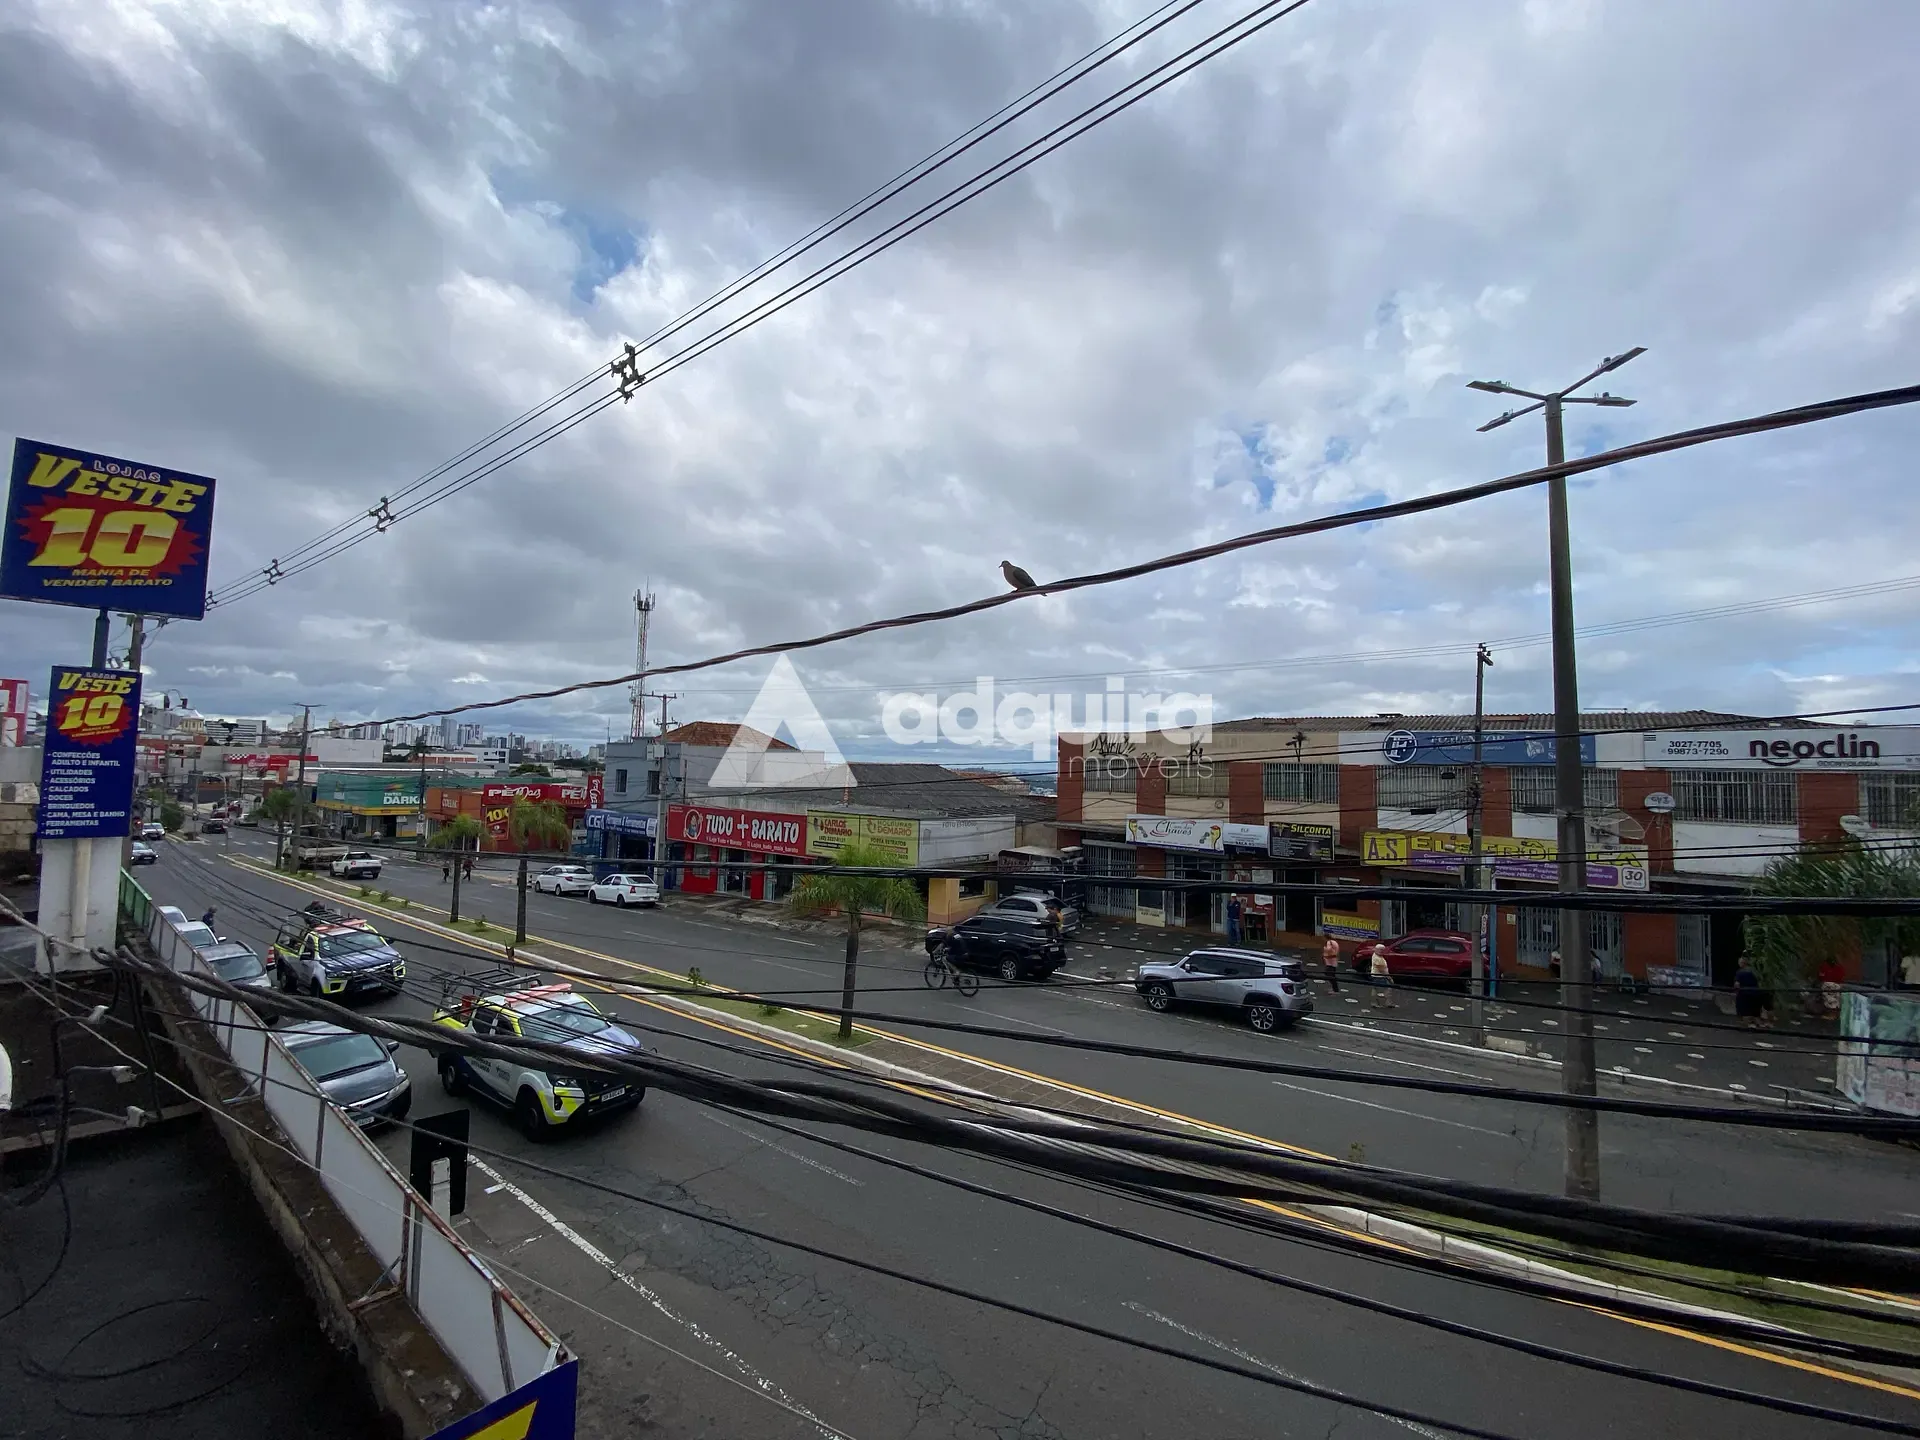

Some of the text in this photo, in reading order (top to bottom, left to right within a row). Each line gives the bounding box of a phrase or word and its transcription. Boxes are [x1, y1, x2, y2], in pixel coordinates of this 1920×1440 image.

[93, 459, 161, 483] LOJAS
[27, 452, 208, 513] VESTE
[27, 507, 179, 567] 10
[71, 568, 151, 577] MANIA DE
[42, 578, 173, 587] VENDER BARATO
[58, 672, 137, 694] VESTE
[58, 694, 124, 730] 10
[1667, 747, 1729, 756] 99873-7290
[1669, 733, 1880, 759] 3027-7705 neoclin
[52, 751, 100, 759] CONFECÇÕES
[824, 818, 847, 827] CARLOS
[705, 813, 800, 844] TUDO + BARATO
[824, 826, 853, 837] DEMARIO
[877, 826, 912, 837] DEMARIO
[1624, 870, 1643, 881] 30
